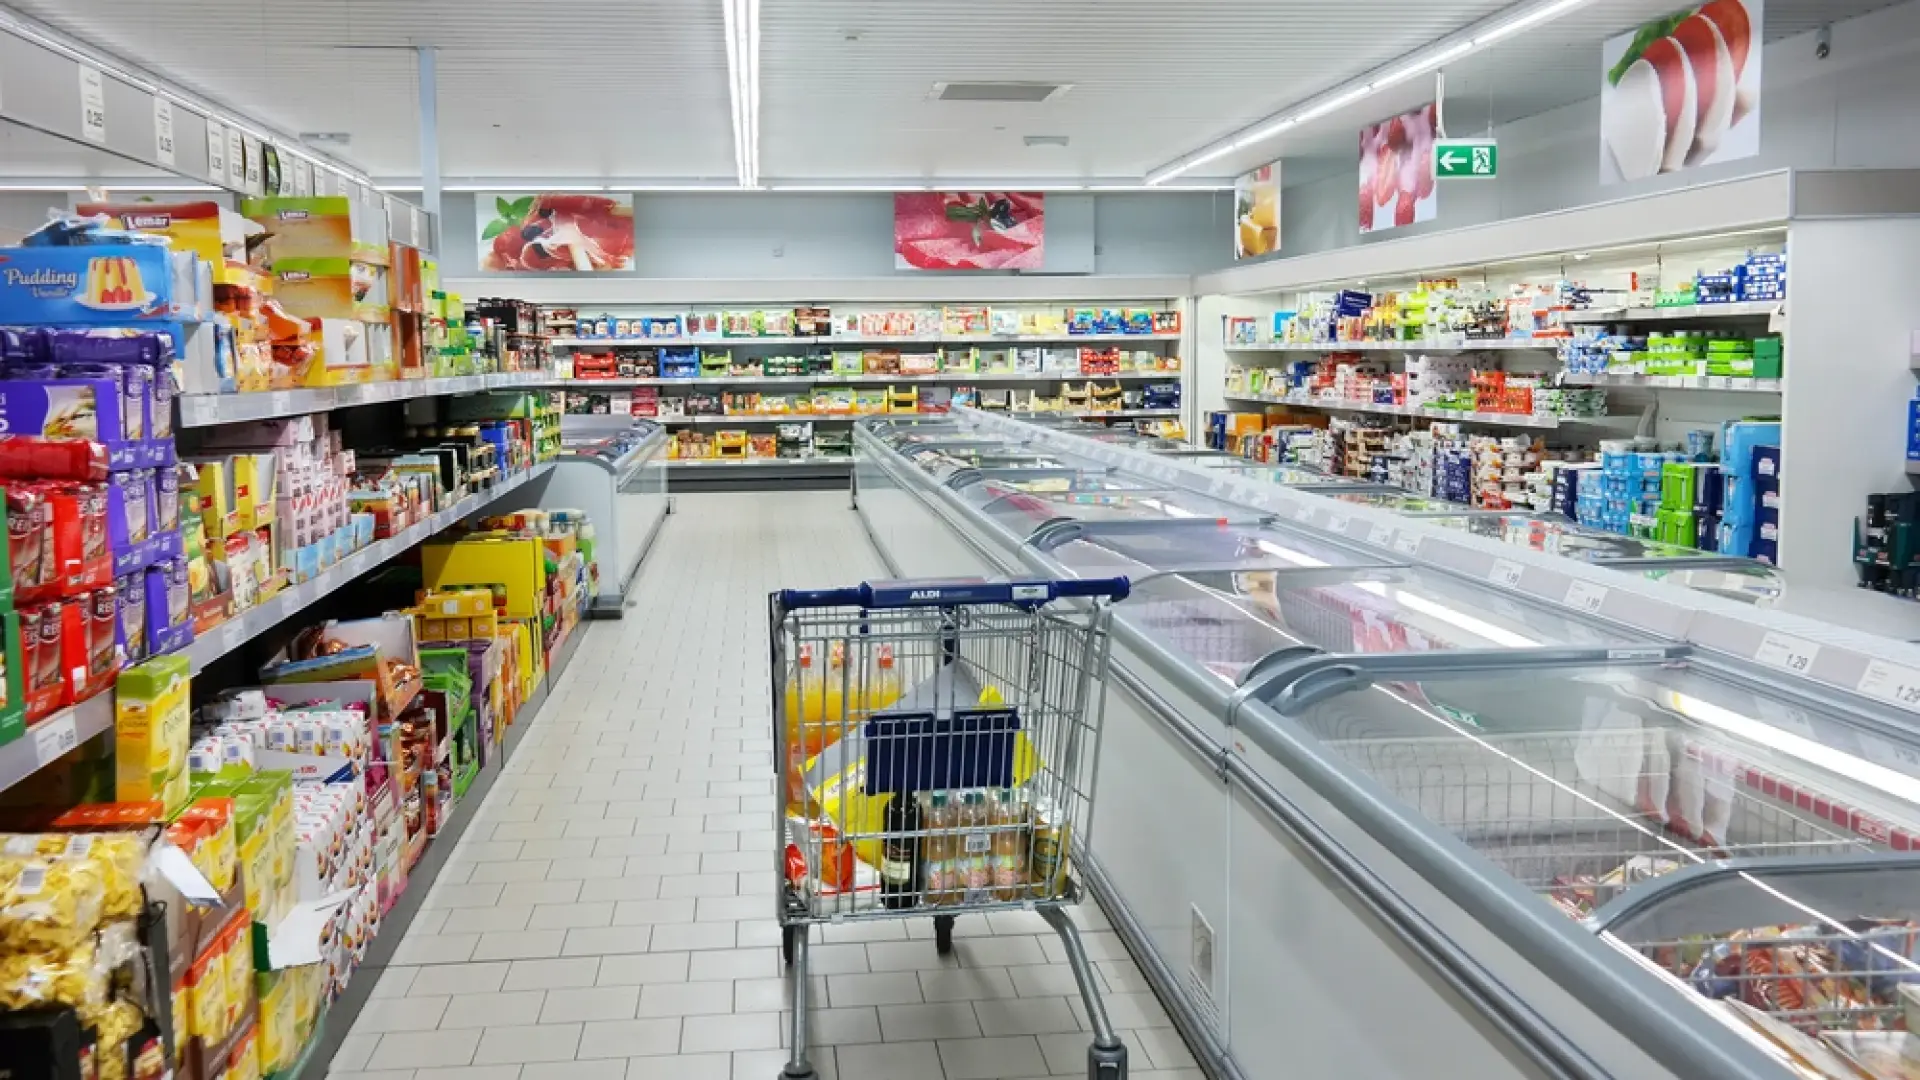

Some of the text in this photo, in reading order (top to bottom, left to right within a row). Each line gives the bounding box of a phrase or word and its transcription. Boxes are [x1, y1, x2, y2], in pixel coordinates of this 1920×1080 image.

[126, 215, 167, 230] Lemar
[4, 268, 78, 287] Pudding
[910, 590, 940, 599] ALDI
[1786, 653, 1809, 670] 1.29
